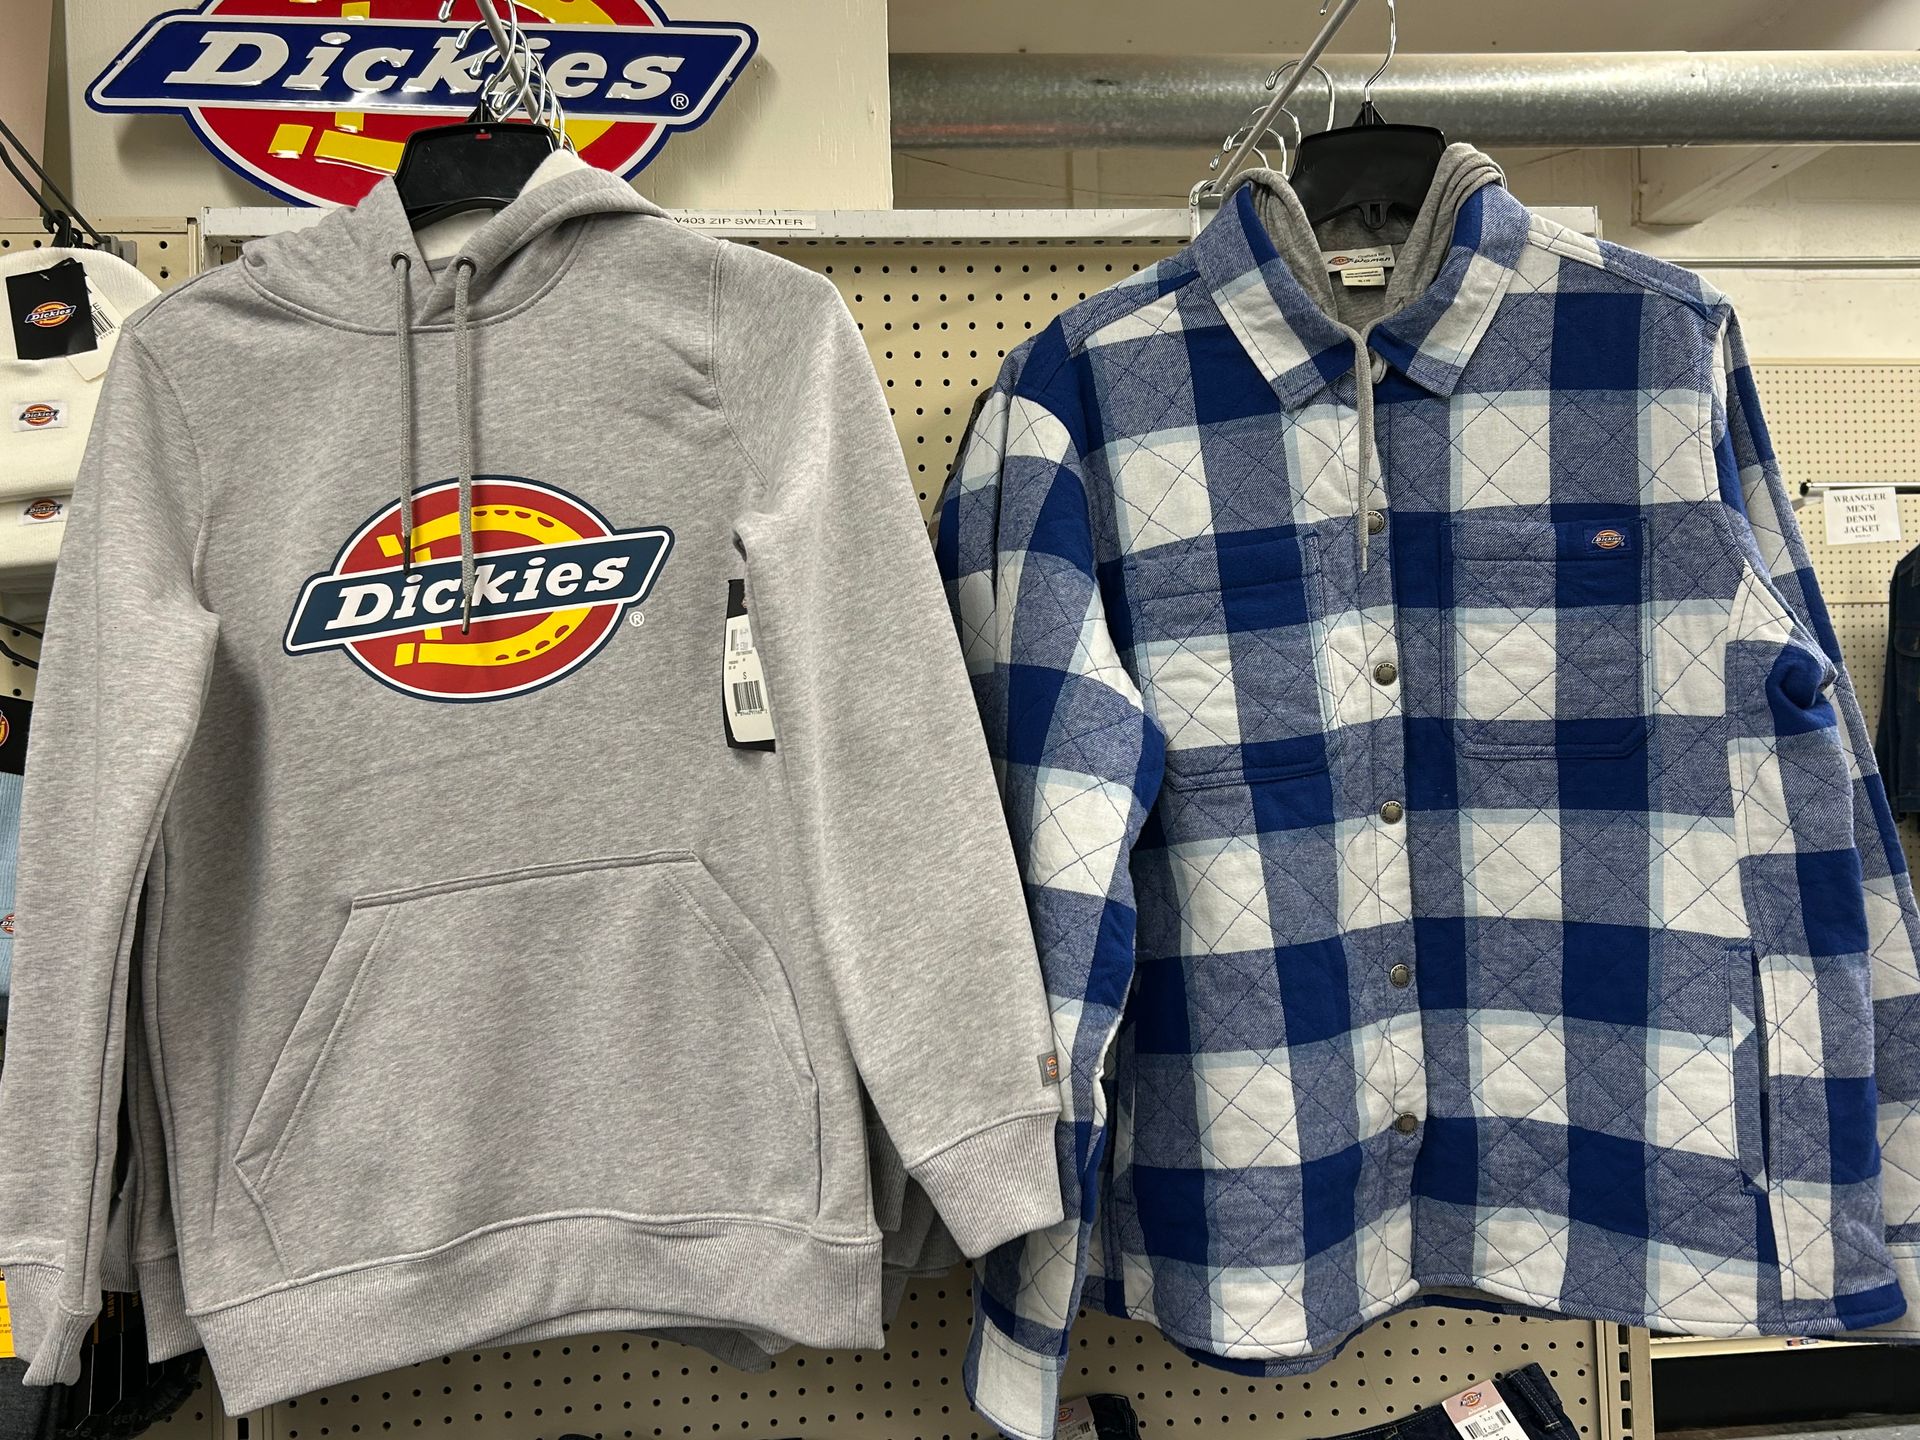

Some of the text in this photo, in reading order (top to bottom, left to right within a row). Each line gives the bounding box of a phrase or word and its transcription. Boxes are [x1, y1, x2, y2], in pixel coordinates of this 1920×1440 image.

[164, 30, 684, 100] Dickies
[709, 217, 732, 225] ZIP
[735, 217, 803, 225] SWEATER
[31, 308, 72, 321] Dickies
[1833, 493, 1886, 503] WRANGLER
[1846, 504, 1875, 513] MEN'S
[1846, 514, 1877, 524] DENIM
[1844, 525, 1880, 533] JACKET
[324, 556, 629, 631] Dickies
